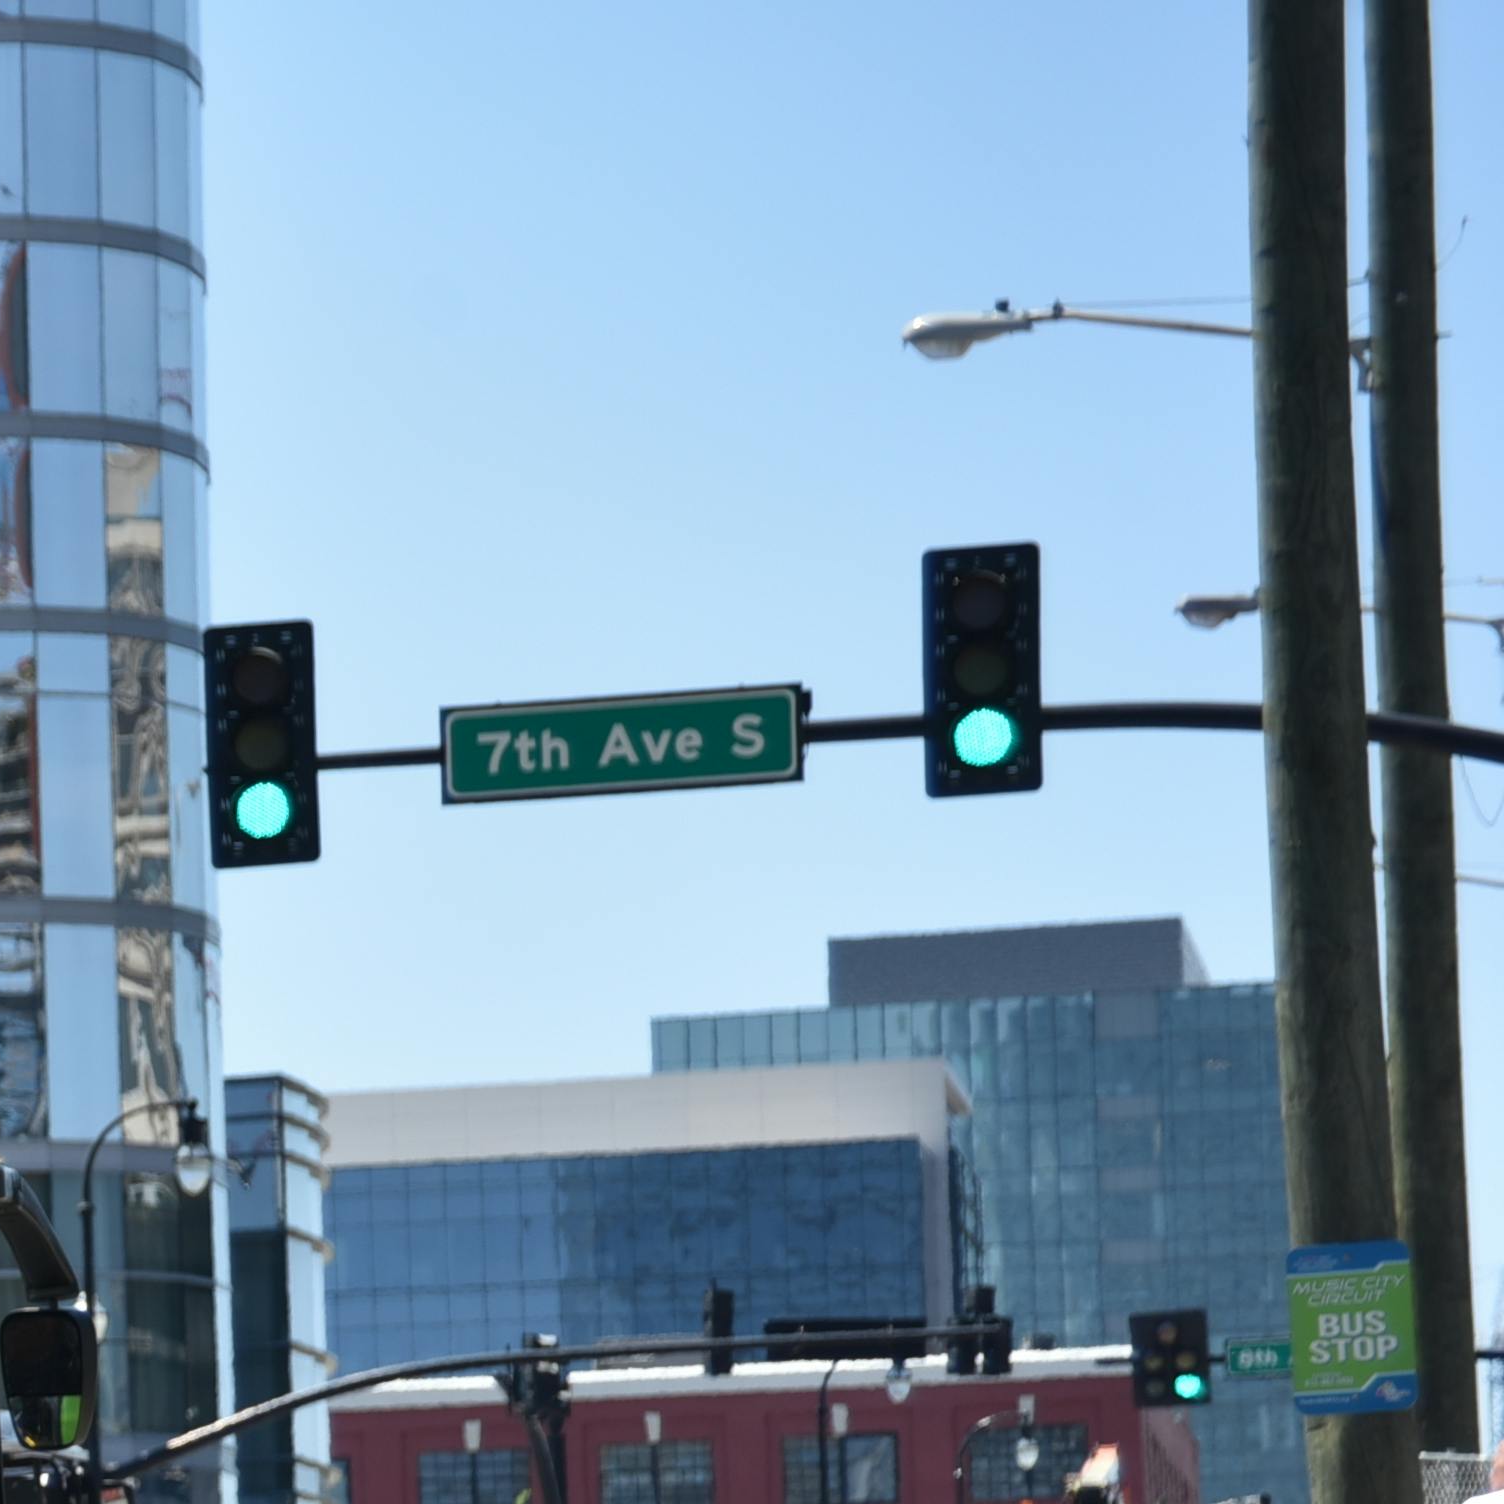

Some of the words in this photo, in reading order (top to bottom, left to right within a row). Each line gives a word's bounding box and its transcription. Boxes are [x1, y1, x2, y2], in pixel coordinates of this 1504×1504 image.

[476, 728, 571, 775] 7th
[597, 721, 704, 769] Ave
[730, 713, 766, 757] S
[1293, 1277, 1358, 1295] MUSIC
[1361, 1274, 1405, 1290] CITY
[1307, 1288, 1386, 1306] CIRCUIT
[1318, 1309, 1386, 1338] BUS
[1309, 1335, 1398, 1364] STOP
